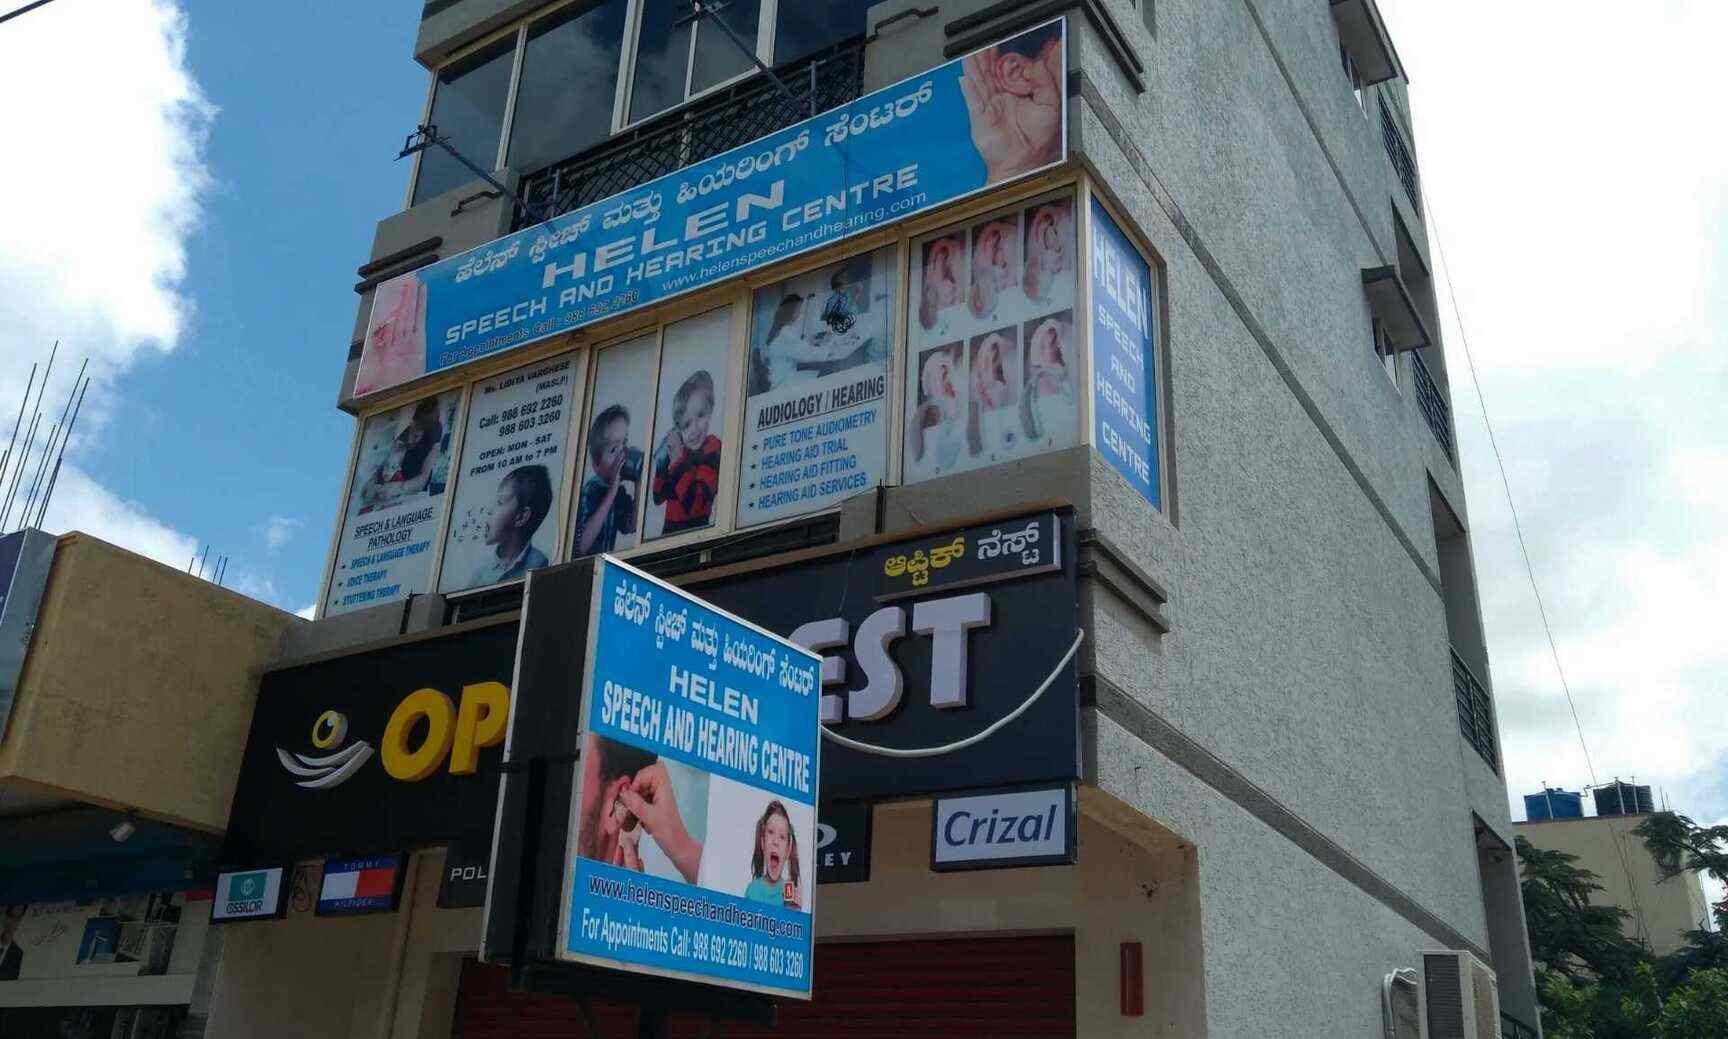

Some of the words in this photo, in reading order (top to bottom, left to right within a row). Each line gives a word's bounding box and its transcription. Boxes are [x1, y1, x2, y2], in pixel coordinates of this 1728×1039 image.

[444, 296, 548, 346] SPEECH
[559, 274, 614, 308] AND
[626, 220, 768, 287] HEARING
[782, 162, 919, 231] CENTRE
[542, 180, 785, 289] HELEN
[661, 190, 927, 292] www.helenspeechandhearing.com
[1094, 231, 1150, 340] HELEN
[1098, 303, 1145, 370] SPEECH
[1111, 353, 1137, 394] AND
[479, 417, 499, 430] Call:
[501, 406, 519, 422] 988
[521, 400, 538, 417] 692
[540, 393, 563, 411] 2260
[499, 421, 517, 437] 988
[518, 416, 535, 432] 603
[537, 409, 561, 426] 3260
[757, 393, 823, 428] AUDIOLOGY
[831, 376, 885, 408] HEARING
[1095, 371, 1151, 445] HEARING
[480, 448, 505, 462] OPEN:
[507, 440, 528, 453] MON
[535, 432, 552, 446] SAT
[763, 431, 788, 451] PURE
[790, 426, 815, 445] TONE
[815, 410, 877, 437] AUDIOMETRY
[1102, 420, 1151, 486] CENTRE
[470, 463, 495, 477] FROM
[497, 458, 507, 470] 10
[509, 455, 523, 467] AM
[544, 445, 558, 457] PM
[760, 468, 801, 490] HEARING
[803, 464, 819, 480] AID
[820, 454, 857, 477] FITTING
[761, 449, 802, 471] HEARING
[804, 445, 820, 461] AID
[822, 438, 848, 457] TRIAL
[758, 488, 800, 510] HEARING
[800, 483, 818, 499] AID
[819, 472, 867, 496] SERVICES
[368, 530, 412, 549] PATHOLOGY
[391, 507, 433, 526] LANGUAGE
[668, 665, 760, 725] HELEN
[601, 680, 662, 742] SPEECH
[663, 705, 696, 754] AND
[697, 716, 759, 777] HEARING
[761, 740, 811, 791] CENTRE
[945, 804, 1057, 847] Crizal
[589, 875, 803, 938] www.helenspeechandhearing.com
[581, 908, 600, 941] For
[601, 913, 668, 953] Appointments
[670, 927, 690, 957] Call:
[693, 931, 709, 964] 988
[711, 938, 726, 964] 692
[728, 941, 747, 969] 2260
[754, 947, 768, 973] 988
[770, 950, 784, 976] 603
[785, 951, 803, 980] 3260
